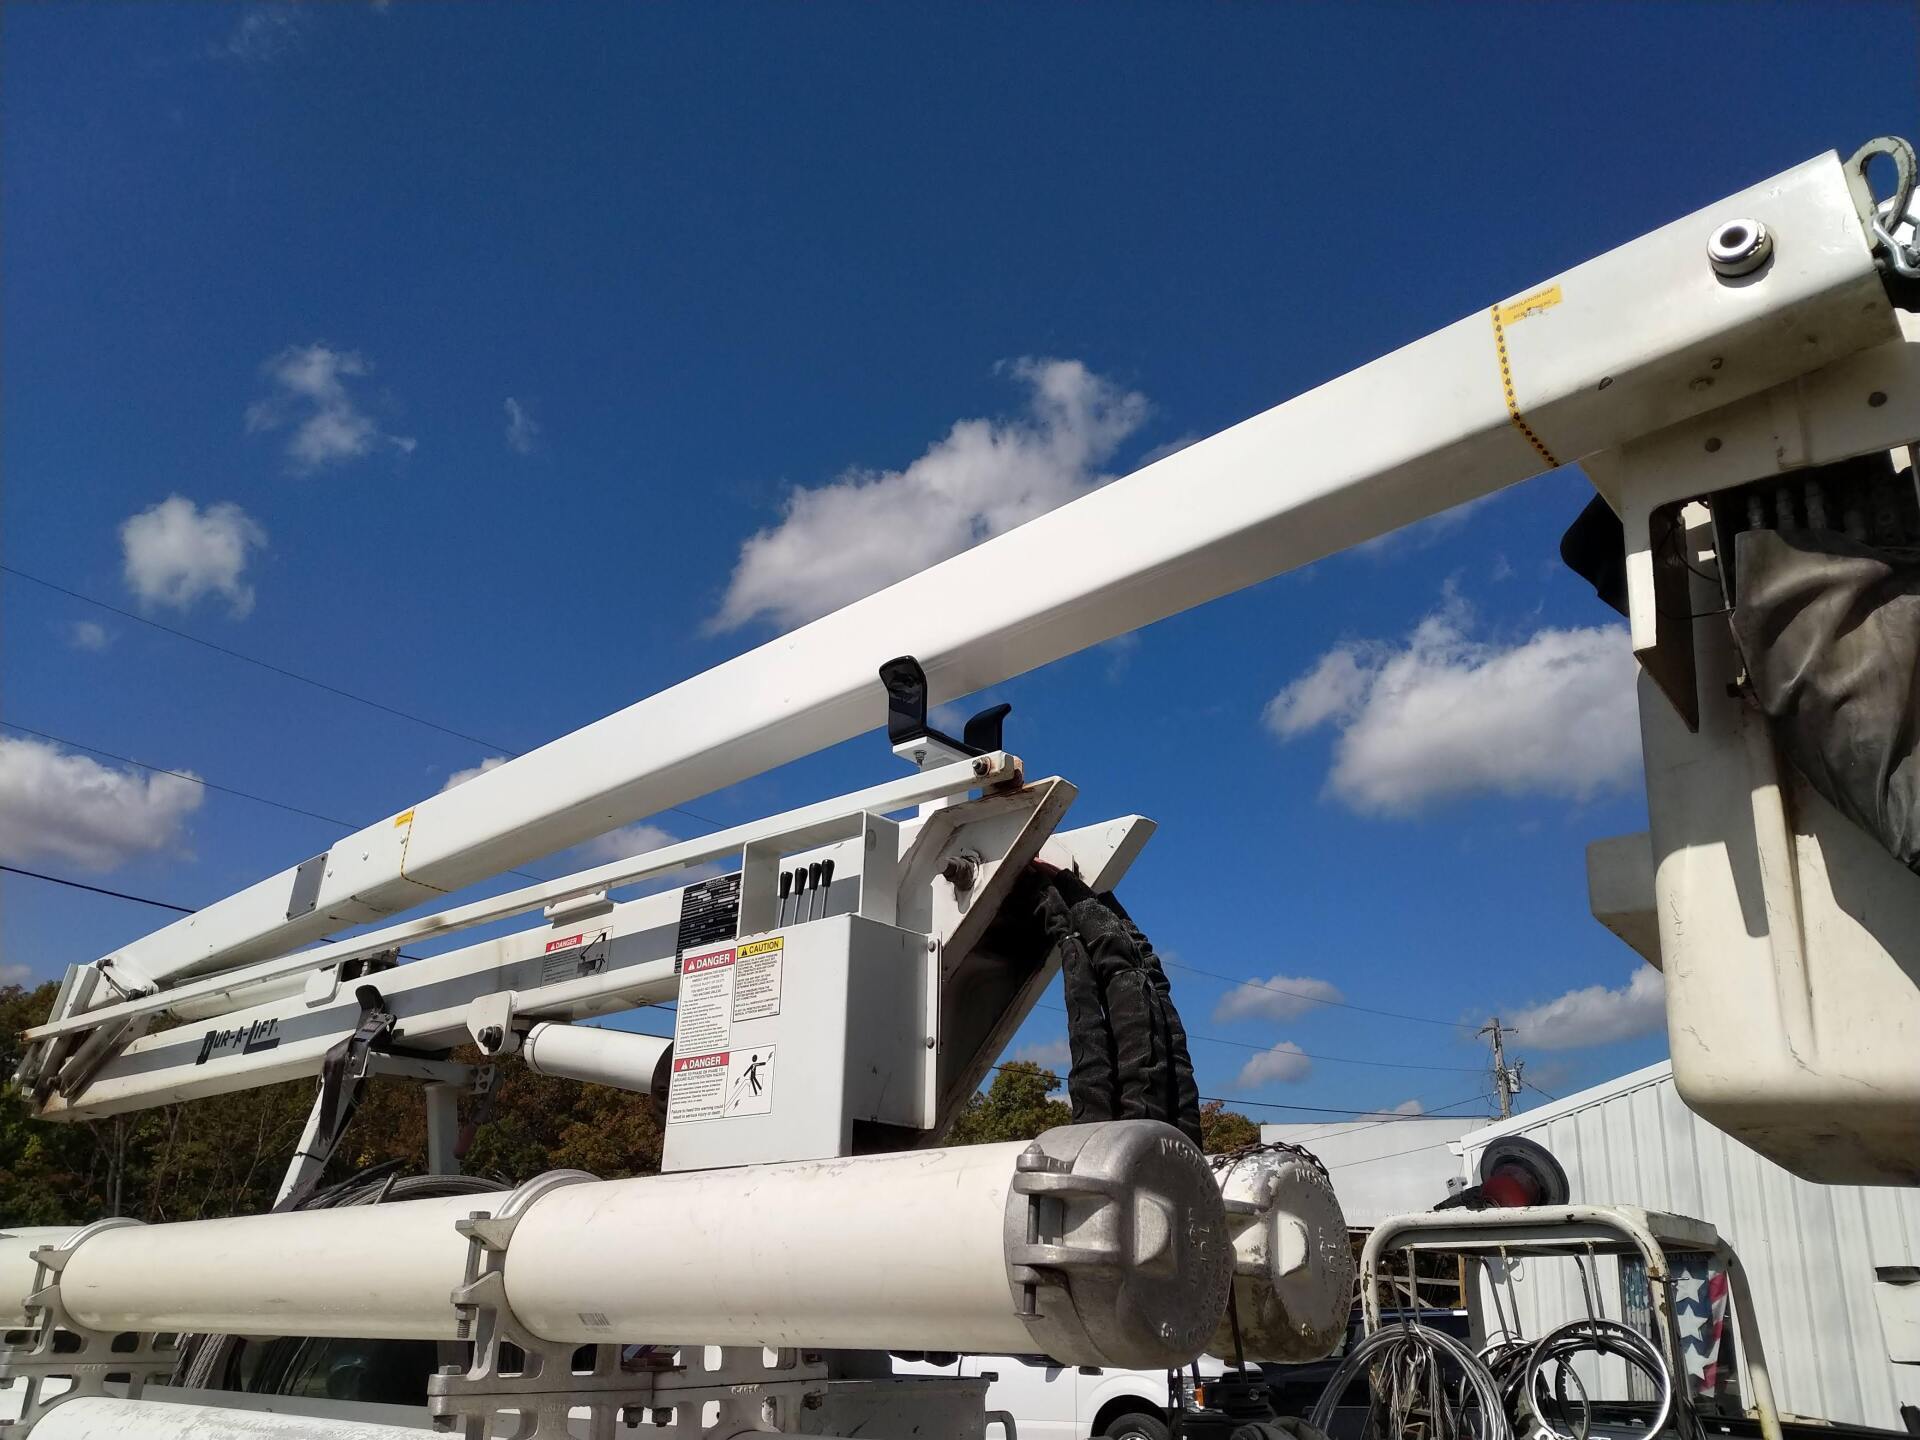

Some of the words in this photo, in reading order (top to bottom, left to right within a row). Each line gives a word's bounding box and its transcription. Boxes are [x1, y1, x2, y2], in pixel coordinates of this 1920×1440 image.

[555, 937, 578, 949] DANGER
[749, 941, 779, 954] CAUTION
[696, 953, 730, 969] DANGER
[689, 1056, 721, 1069] DANGER
